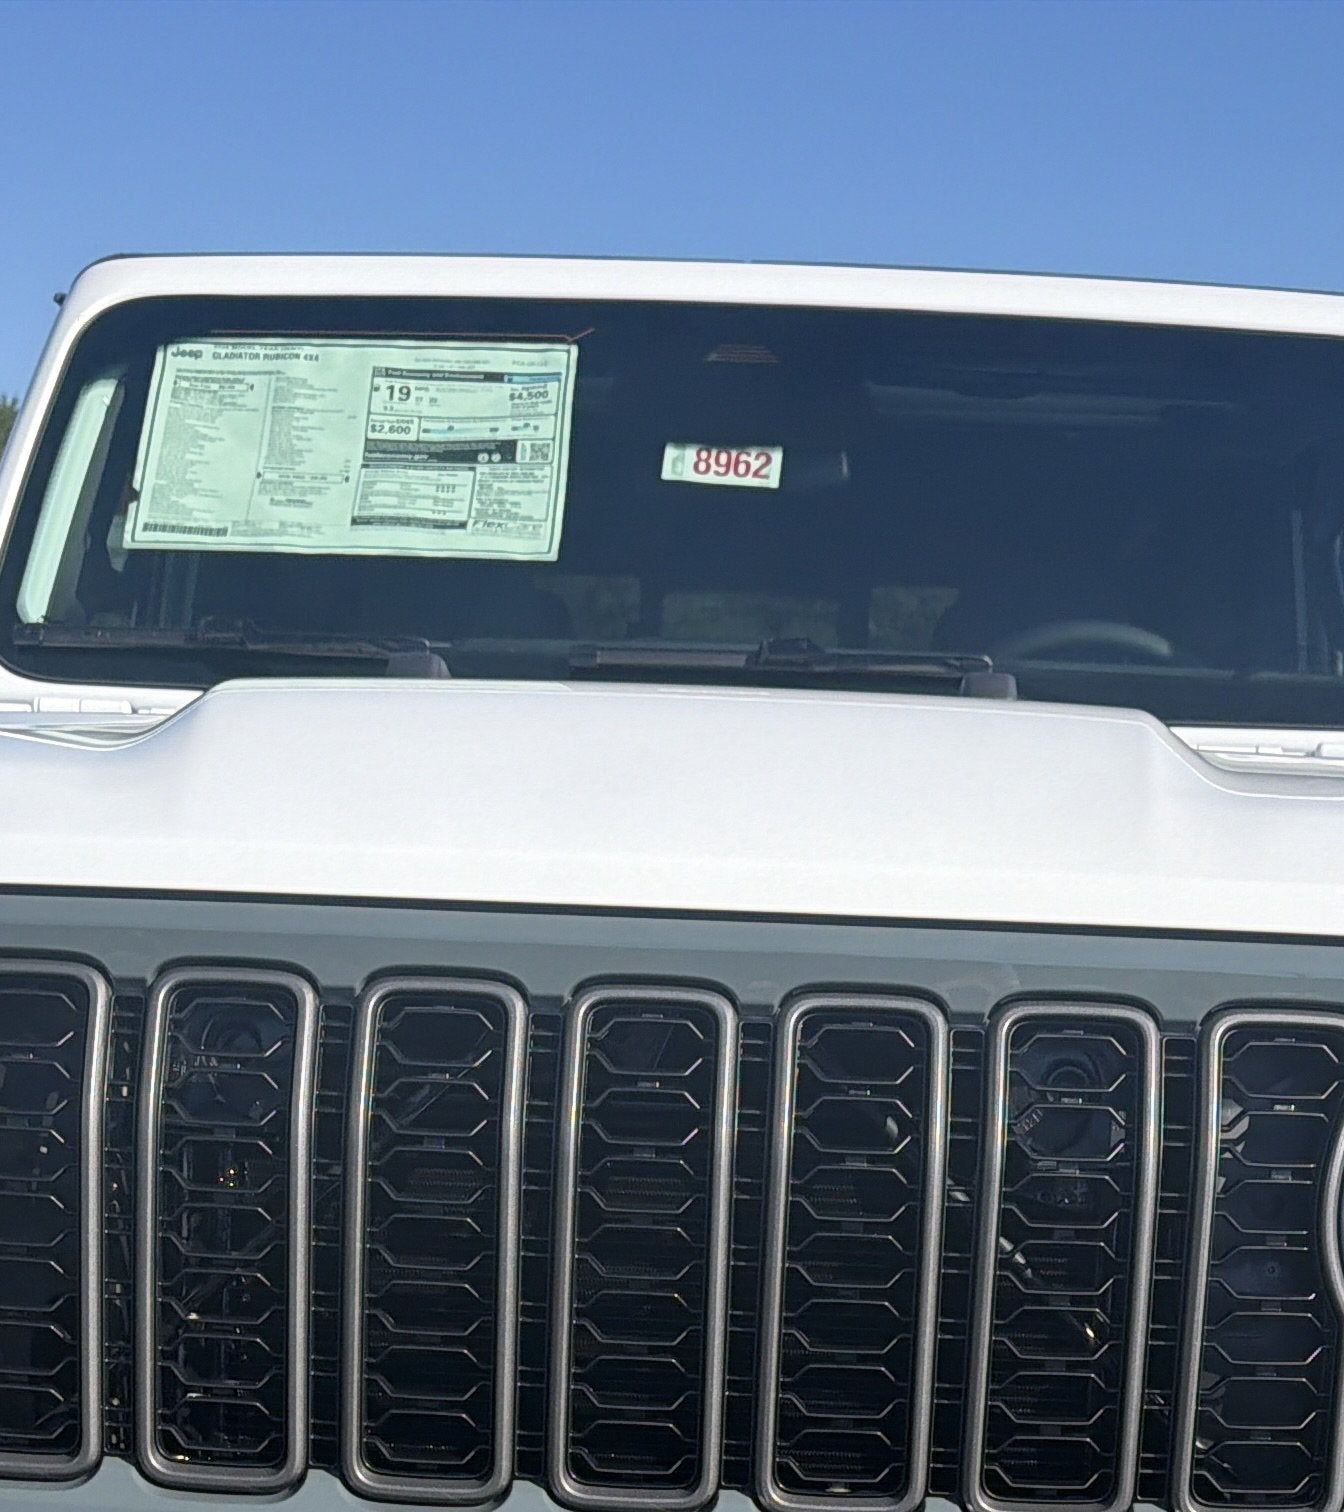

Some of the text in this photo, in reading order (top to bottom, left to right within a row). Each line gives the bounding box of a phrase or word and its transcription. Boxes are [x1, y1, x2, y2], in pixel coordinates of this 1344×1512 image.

[171, 346, 203, 360] Jeep
[212, 351, 261, 361] GLADIATOR
[263, 352, 301, 362] RUBICON
[386, 385, 411, 402] 19
[508, 390, 549, 402] $4,500
[370, 423, 412, 436] $2,600
[693, 447, 773, 480] 8962
